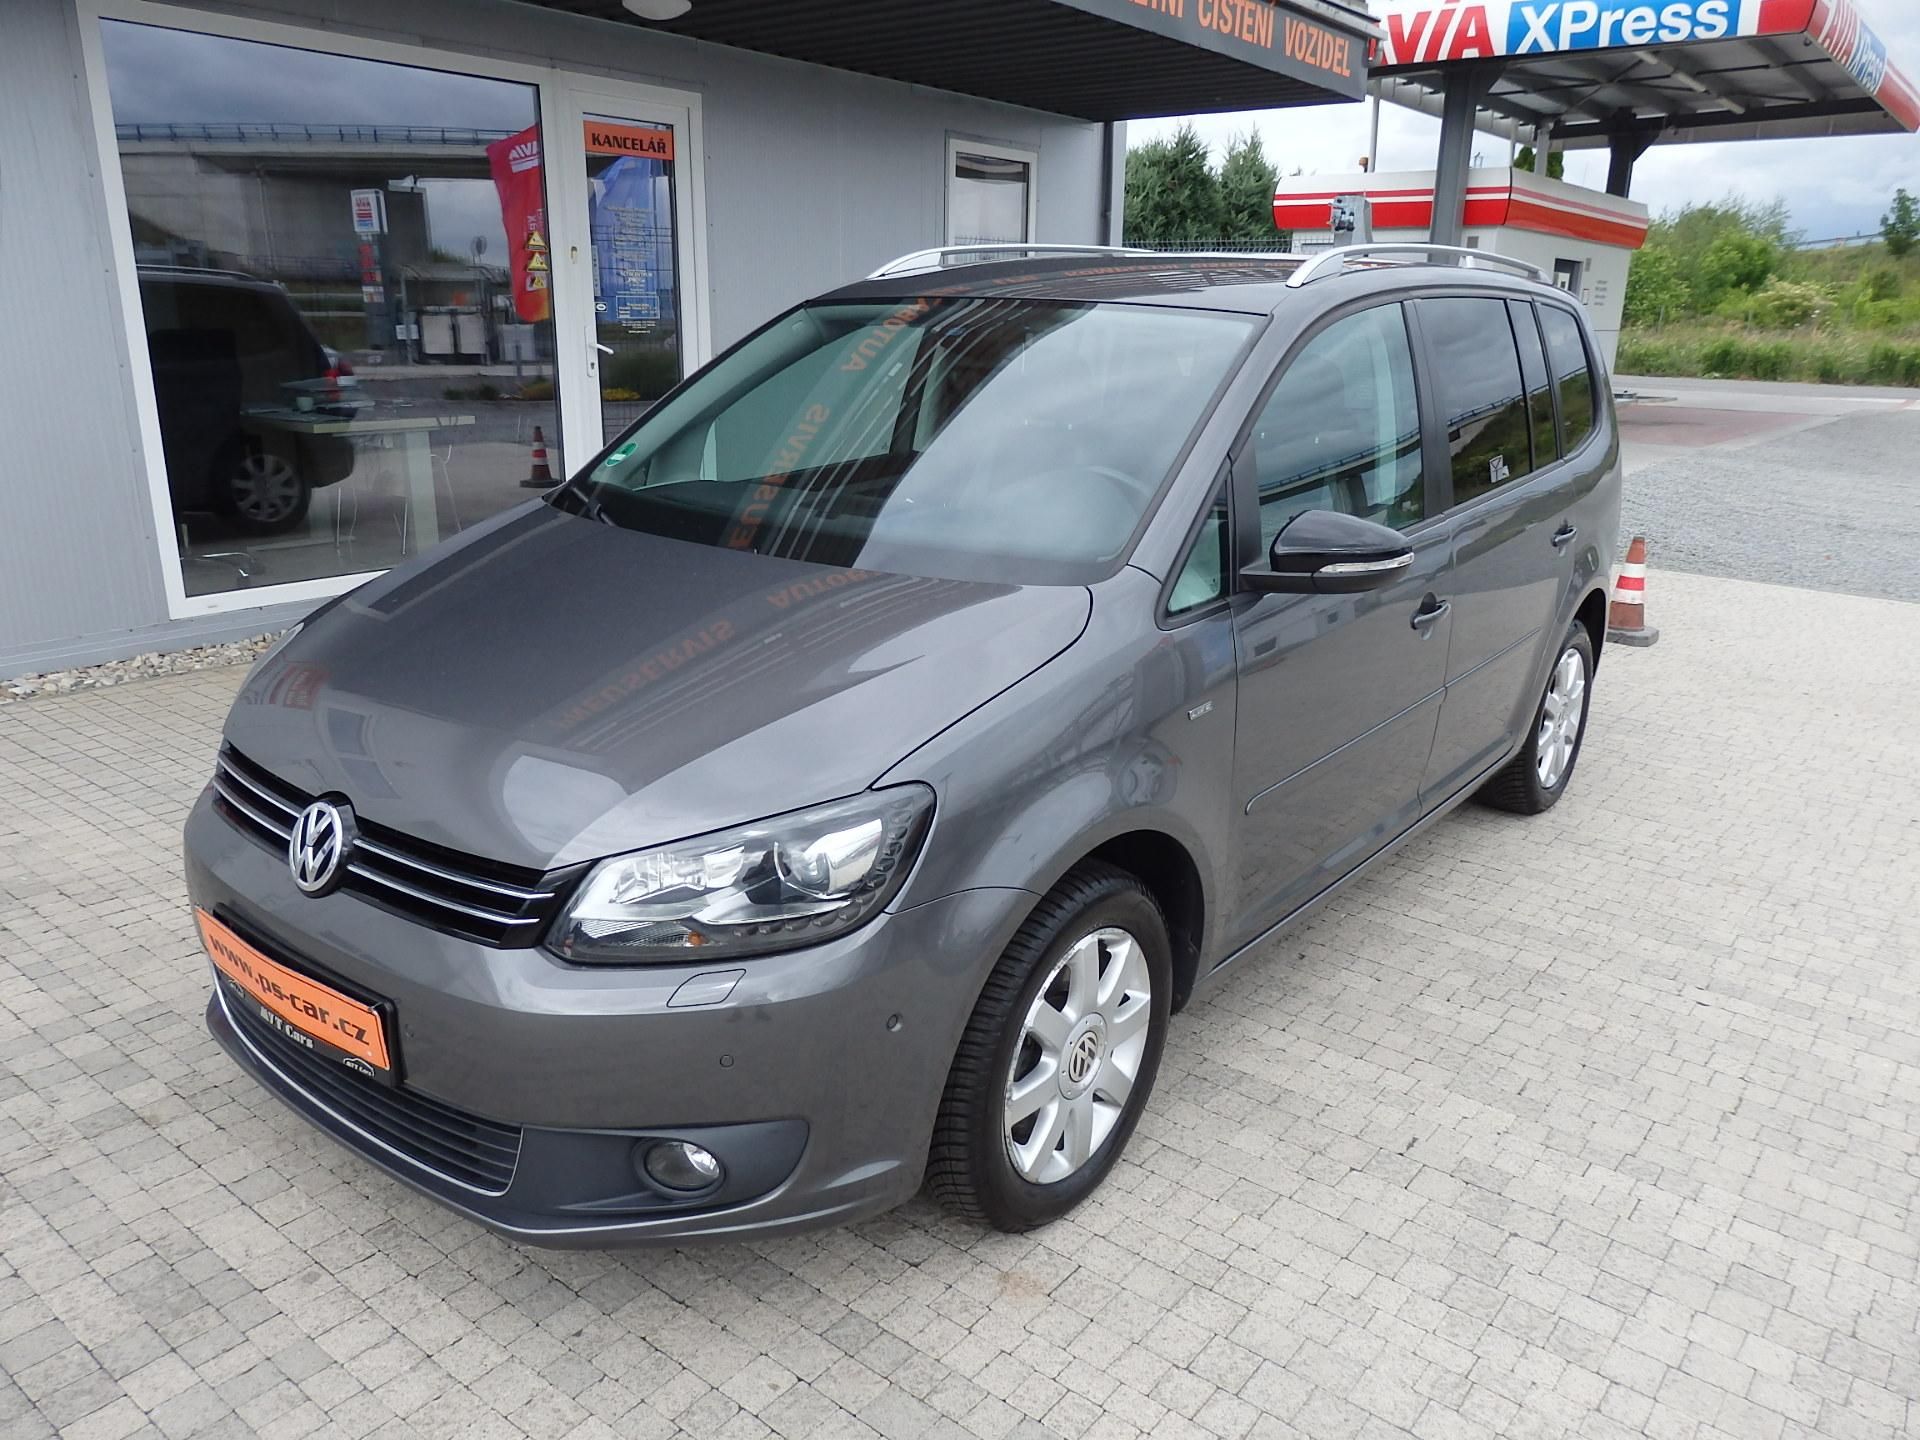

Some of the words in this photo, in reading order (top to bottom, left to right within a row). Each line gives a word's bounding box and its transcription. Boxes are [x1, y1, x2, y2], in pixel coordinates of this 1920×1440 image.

[1284, 16, 1351, 78] VOZIDEL
[1368, 4, 1497, 67] VIA
[1513, 1, 1730, 55] XPress
[591, 132, 667, 154] KANCELÁŘ
[208, 933, 370, 1046] www.ps-car.cz
